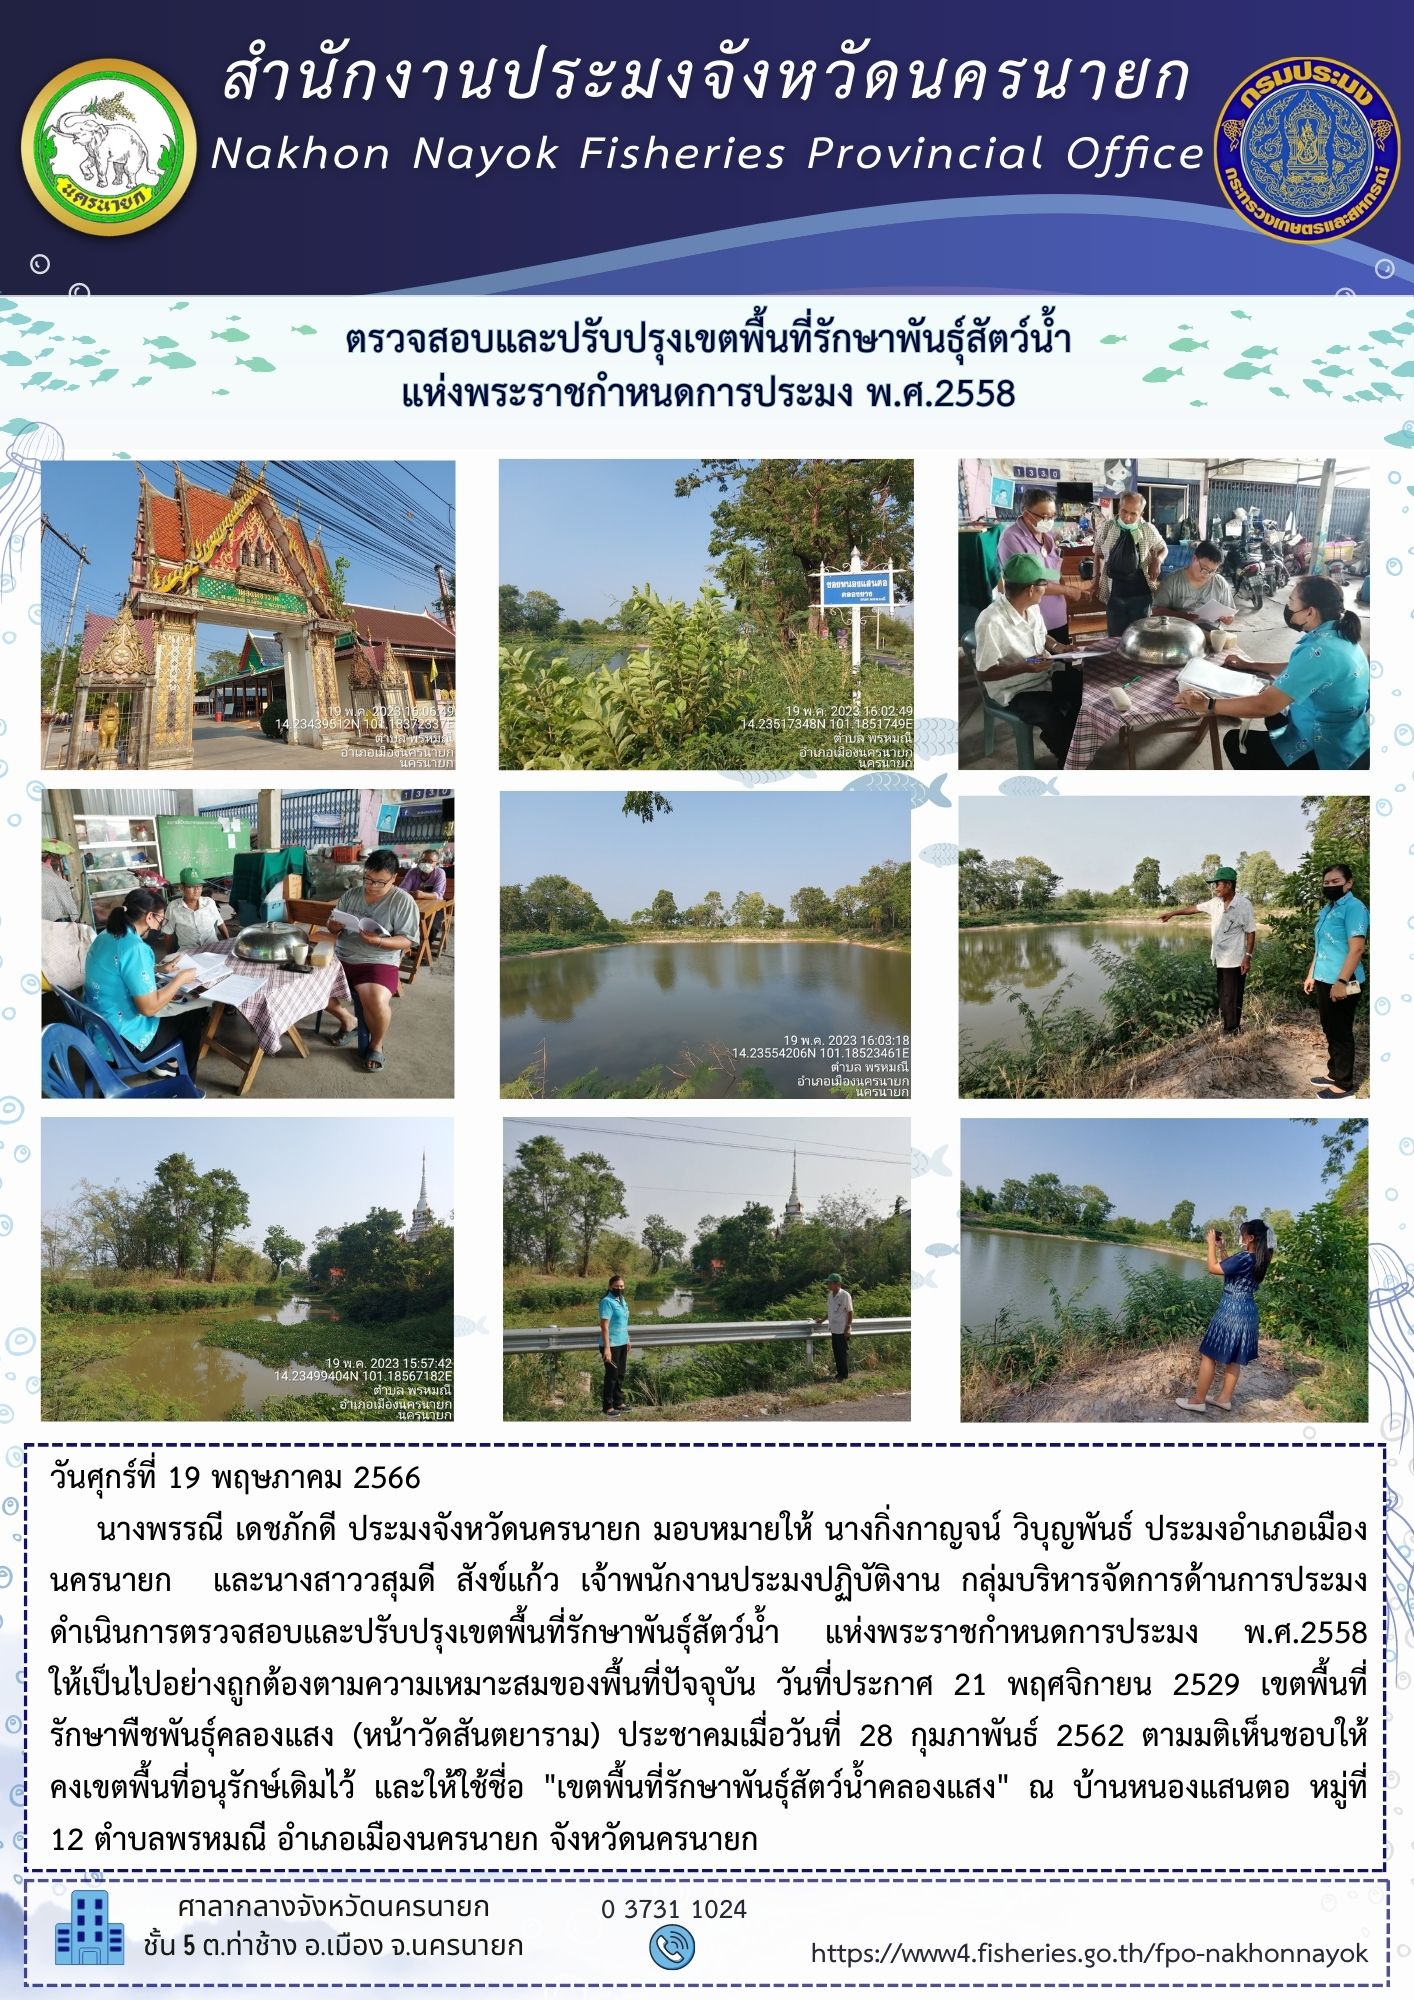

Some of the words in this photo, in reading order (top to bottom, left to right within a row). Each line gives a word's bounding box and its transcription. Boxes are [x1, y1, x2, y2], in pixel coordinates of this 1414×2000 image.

[223, 37, 1190, 101] สำนักงานประมงจังหวัดนครนายก
[1240, 61, 1374, 109] กรมประมง
[211, 134, 390, 170] Nakhon
[413, 134, 559, 178] Nayok
[580, 134, 786, 170] Fisheries
[807, 134, 1043, 170] Provincial
[1067, 134, 1204, 179] Office
[61, 182, 147, 213] นครนายก
[1225, 165, 1390, 236] กระทรวงเกษตรและสหกรณ์
[346, 305, 1072, 366] ตรวจสอบและปรับปรุงเขตพื้นที่รักษาพันธุ์สัตว์น้ำ
[402, 371, 853, 408] แห่งพระราชกำหนดการประมง
[866, 378, 1016, 408] พ.ศ.2558
[50, 1452, 155, 1499] วันศุกร์ที่
[170, 1465, 200, 1490] 19
[211, 1465, 342, 1495] พฤษภาคม
[353, 1465, 421, 1489] 2566
[97, 1510, 223, 1541] นางพรรณี
[236, 1510, 336, 1541] เดชภักดี
[348, 1510, 640, 1541] ประมงจังหวัดนครนายก
[653, 1509, 814, 1541] มอบหมายให้
[824, 1503, 1002, 1550] นางกิ่งกาญจน์
[1012, 1509, 1134, 1551] วิบุญพันธ์
[1145, 1510, 1367, 1541] ประมงอำเภอเมือง
[49, 1572, 171, 1592] นครนายก
[214, 1561, 435, 1602] และนางสาววสุมดี
[456, 1560, 559, 1592] สังข์แก้ว
[582, 1560, 940, 1602] เจ้าพนักงานประมงปฏิบัติงาน
[962, 1560, 1367, 1602] กลุ่มบริหารจัดการด้านการประมง
[50, 1605, 779, 1654] ดำเนินการตรวจสอบและปรับปรุงเขตพื้นที่รักษาพันธุ์สัตว์น้ำ
[826, 1613, 1198, 1644] แห่งพระราชกำหนดการประมง
[1244, 1620, 1368, 1644] พ.ศ.2558
[48, 1657, 756, 1706] ให้เป็นไปอย่างถูกต้องตามความเหมาะสมของพื้นที่ปัจจุบัน
[776, 1659, 933, 1696] วันที่ประกาศ
[954, 1672, 986, 1696] 21
[1007, 1667, 1152, 1702] พฤศจิกายน
[1173, 1672, 1240, 1696] 2529
[1262, 1656, 1367, 1696] เขตพื้นที่
[50, 1715, 333, 1758] รักษาพืชพันธุ์คลองแสง
[353, 1715, 600, 1750] (หน้าวัดสันตยาราม)
[618, 1709, 841, 1747] ประชาคมเมื่อวันที่
[859, 1723, 893, 1747] 28
[911, 1715, 1039, 1758] กุมภาพันธ์
[1056, 1723, 1124, 1747] 2562
[1142, 1714, 1369, 1747] ตามมติเห็นชอบให้
[50, 1759, 356, 1810] คงเขตพื้นที่อนุรักษ์เดิมไว้
[375, 1761, 523, 1799] และให้ใช้ชื่อ
[545, 1759, 1008, 1810] "เขตพื้นที่รักษาพันธุ์สัตว์น้ำคลองแสง"
[1029, 1777, 1054, 1799] ณ
[1073, 1767, 1290, 1799] บ้านหนองแสนตอ
[1309, 1761, 1367, 1810] หมู่ที่
[52, 1827, 84, 1851] 12
[94, 1820, 266, 1851] ตำบลพรหมณี
[277, 1820, 538, 1851] อำเภอเมืองนครนายก
[549, 1820, 757, 1851] จังหวัดนครนายก
[178, 1893, 489, 1917] ศาลากลางจังหวัดนครนายก
[601, 1899, 615, 1919] 0
[624, 1899, 680, 1919] 3731
[692, 1899, 747, 1919] 1024
[144, 1927, 175, 1956] ชั้น
[184, 1934, 195, 1956] 5
[203, 1931, 297, 1956] ต.ท่าช้าง
[305, 1931, 383, 1956] อ.เมือง
[391, 1938, 523, 1956] จ.นครนายก
[811, 1942, 1369, 1969] https://www4.fisheries.go.th/fpo-nakhonnayok
